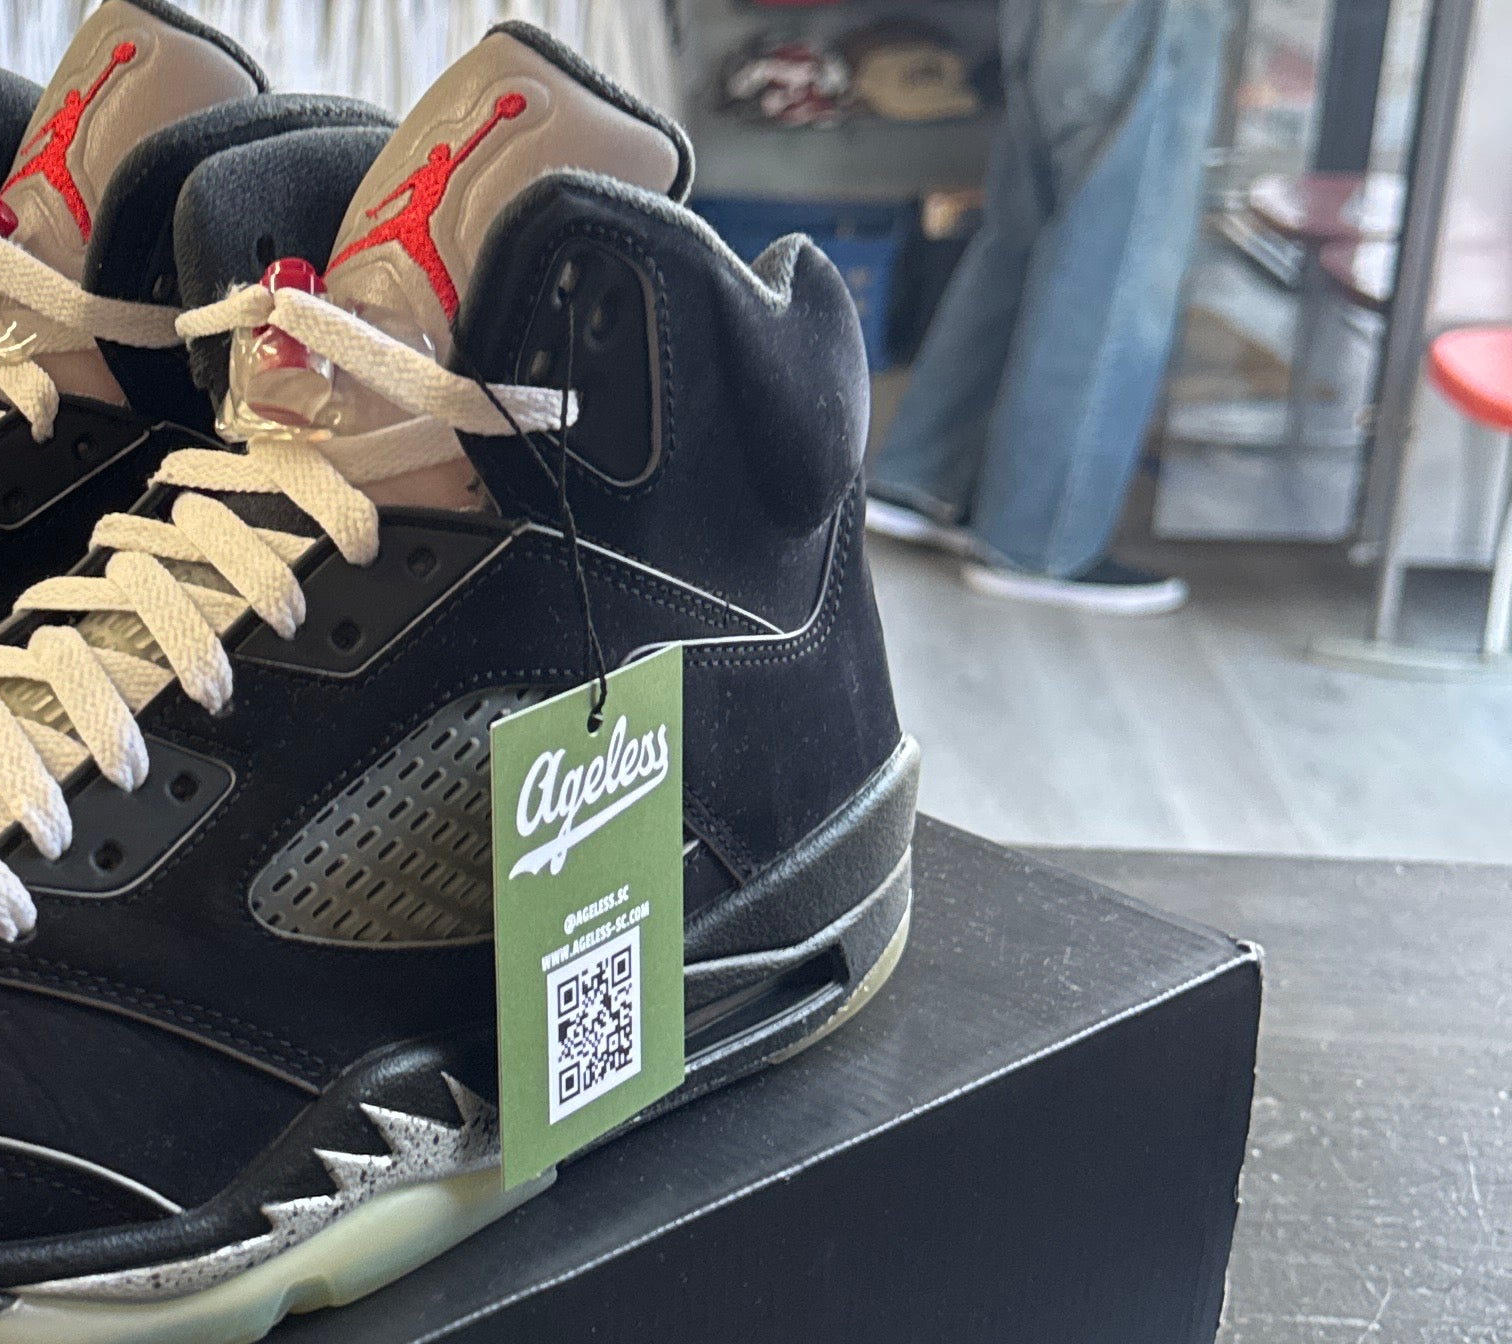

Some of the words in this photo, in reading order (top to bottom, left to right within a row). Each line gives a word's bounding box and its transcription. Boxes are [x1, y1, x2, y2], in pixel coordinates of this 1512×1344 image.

[509, 714, 669, 880] Ageless
[541, 900, 650, 972] WWW.AGELESS-SC.COM
[563, 884, 630, 935] @AGELESS.SC
